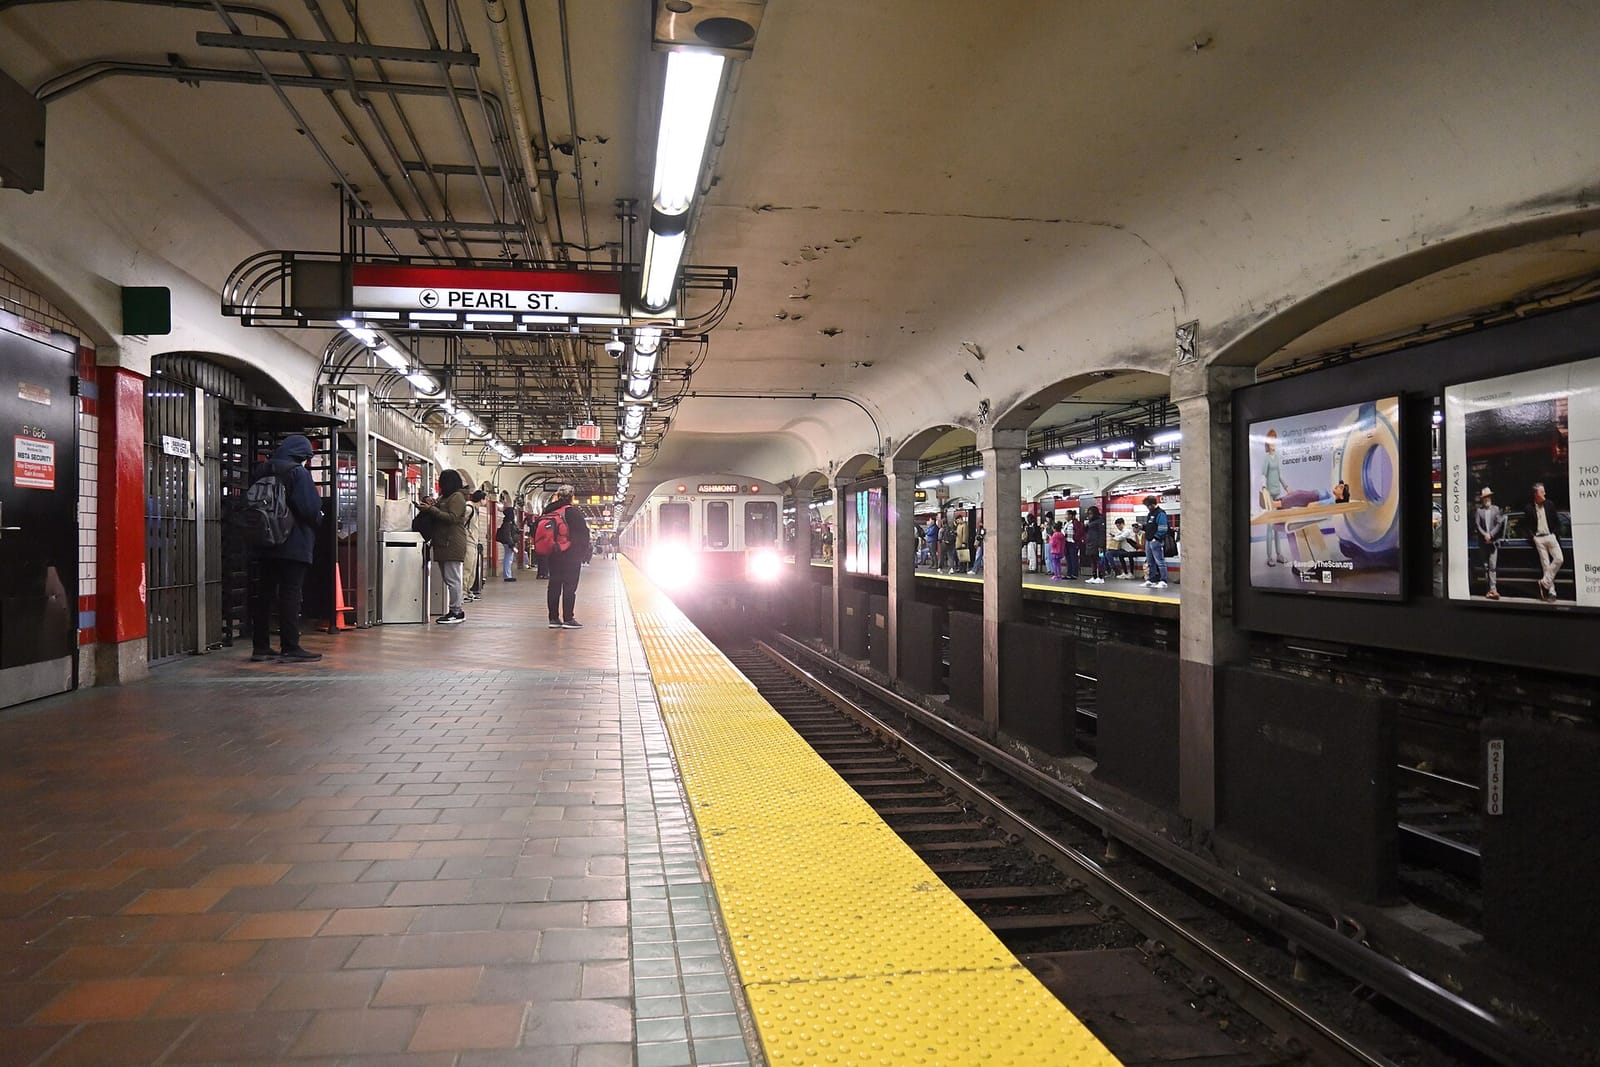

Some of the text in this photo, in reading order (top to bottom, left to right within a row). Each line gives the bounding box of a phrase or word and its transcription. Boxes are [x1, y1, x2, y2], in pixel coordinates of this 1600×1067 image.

[448, 291, 558, 310] PEARL ST.
[580, 427, 597, 439] EXIT
[31, 453, 51, 462] SECURITY
[1282, 457, 1300, 465] cancer
[1579, 478, 1599, 486] AND
[1579, 490, 1600, 499] HAV
[1491, 742, 1502, 750] RS
